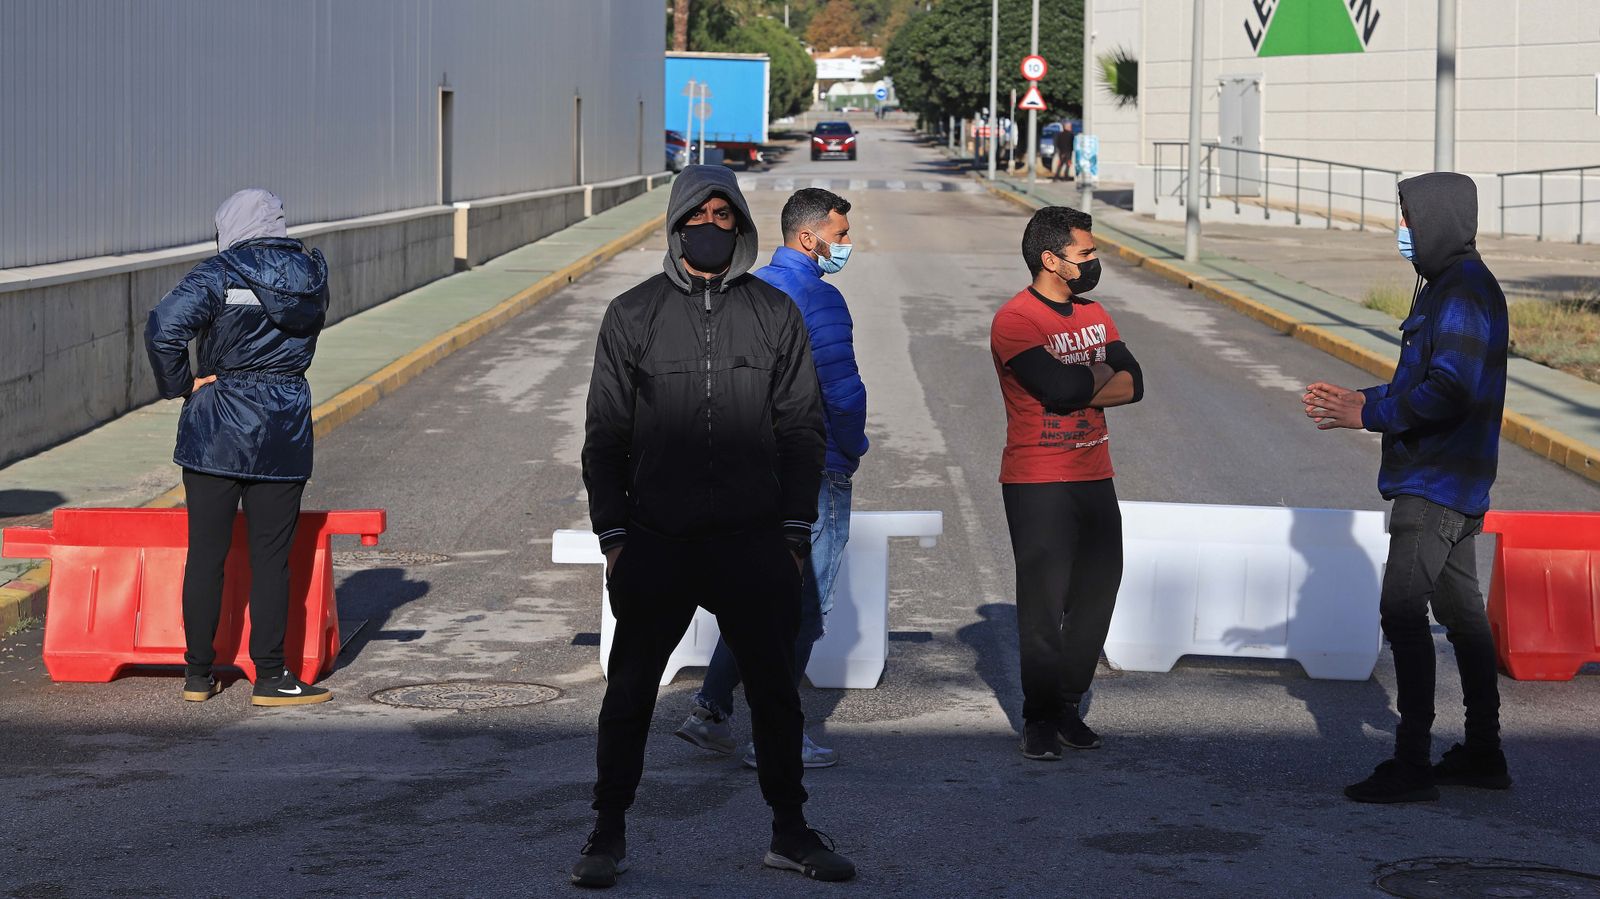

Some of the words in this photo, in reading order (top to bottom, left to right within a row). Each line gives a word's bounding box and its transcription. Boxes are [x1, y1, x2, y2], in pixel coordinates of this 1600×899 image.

[1028, 64, 1040, 73] 10
[1043, 419, 1061, 429] THE
[1040, 430, 1086, 440] ANSWER
